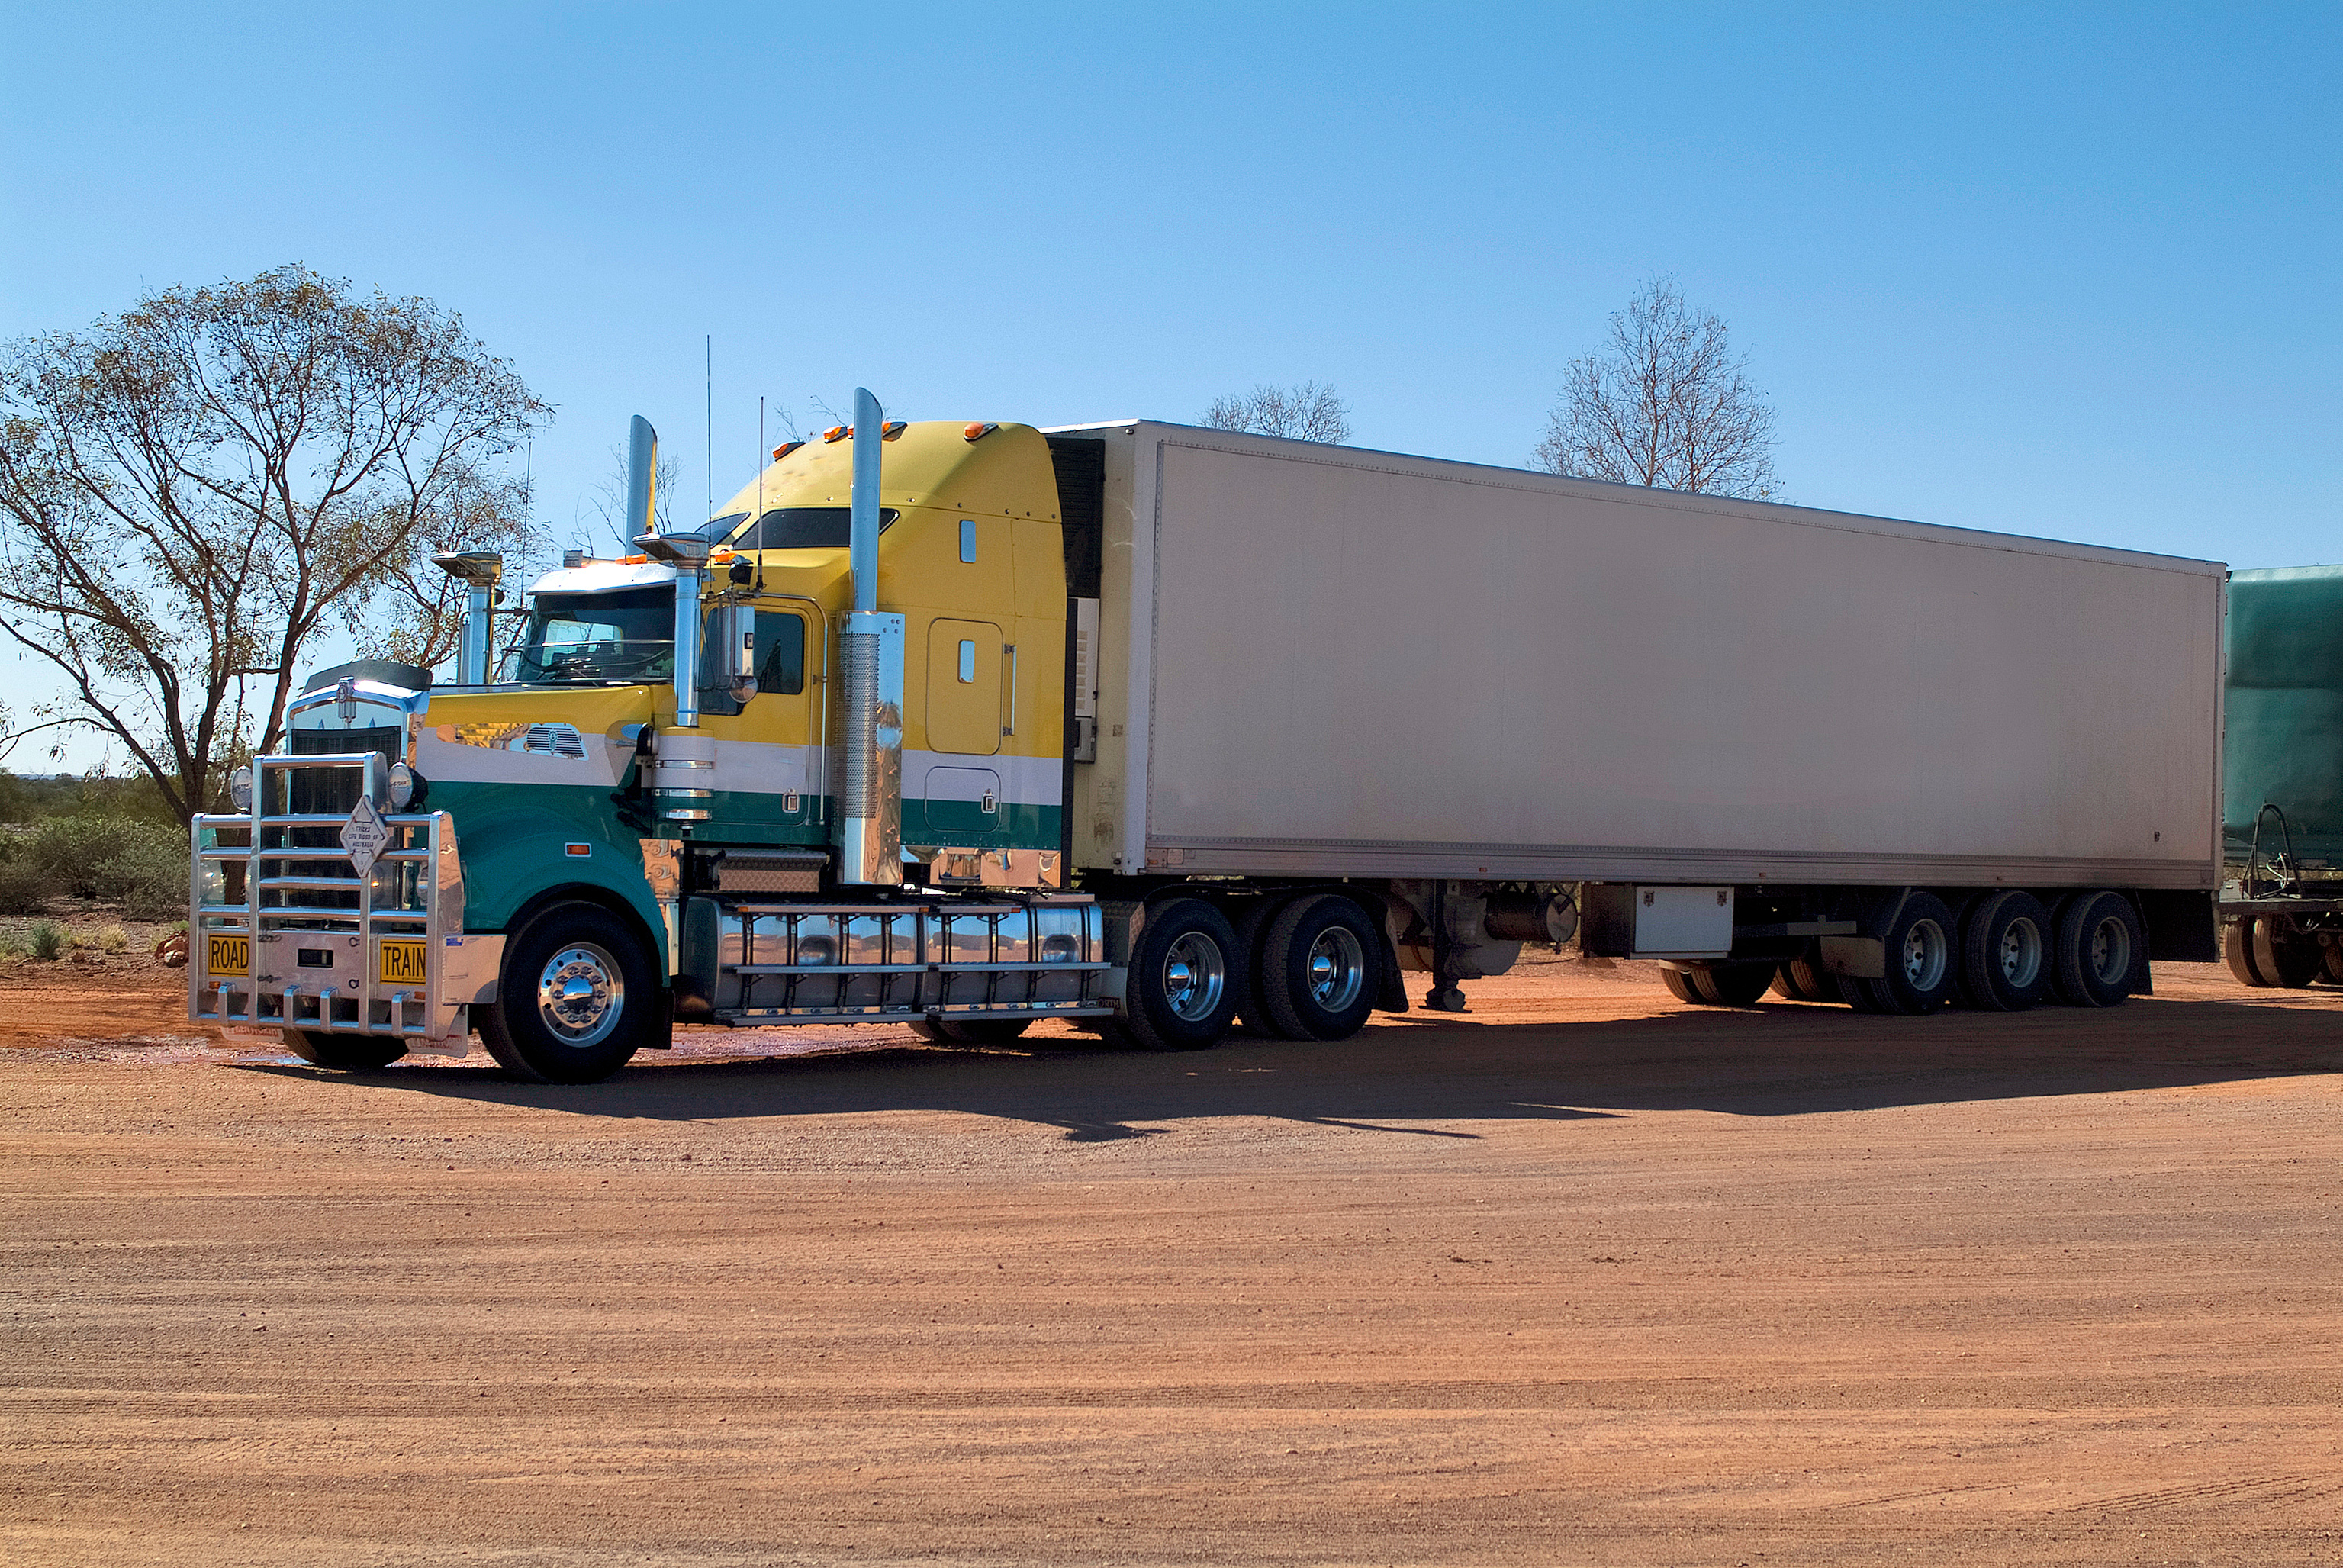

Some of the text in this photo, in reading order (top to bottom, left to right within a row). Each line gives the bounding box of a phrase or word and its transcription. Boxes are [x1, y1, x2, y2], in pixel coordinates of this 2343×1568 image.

[211, 940, 249, 969] ROAD
[384, 946, 426, 977] TRAIN
[1098, 999, 1120, 1009] ORTH
